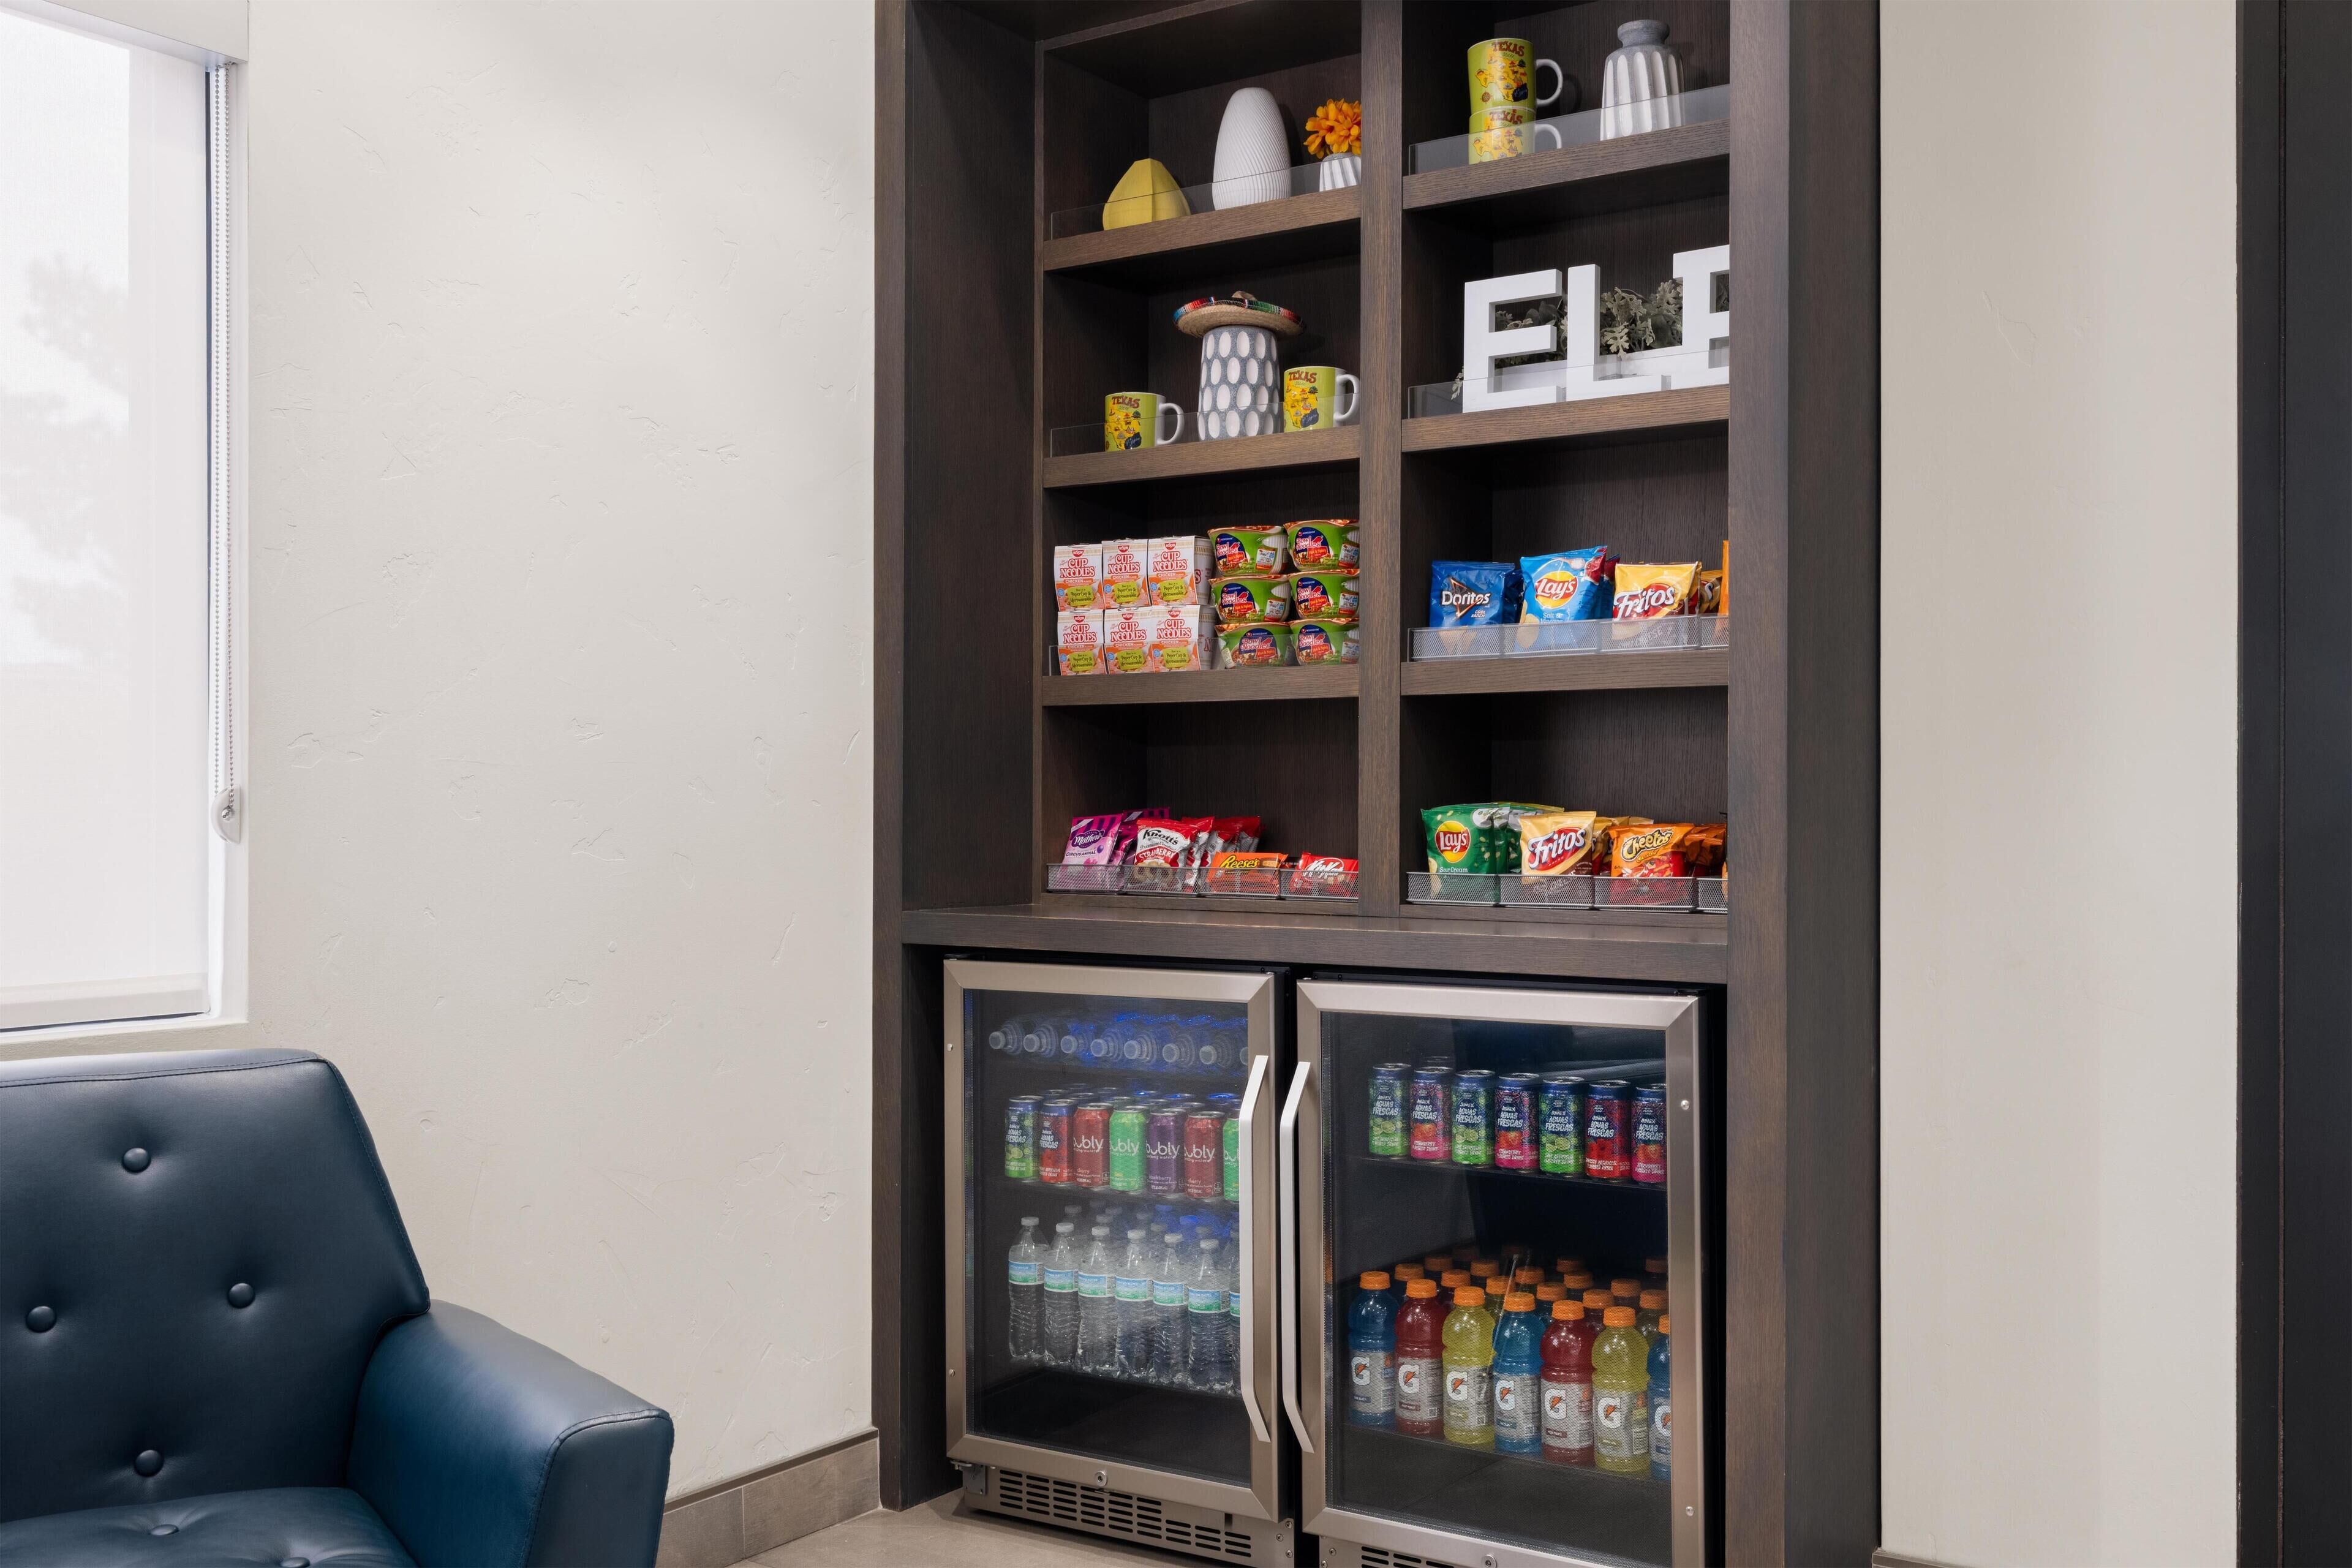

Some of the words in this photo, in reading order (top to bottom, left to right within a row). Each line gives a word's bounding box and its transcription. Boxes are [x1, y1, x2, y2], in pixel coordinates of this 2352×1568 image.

[1491, 41, 1525, 56] TEXAS
[1289, 371, 1317, 383] TEXAS
[1112, 396, 1140, 409] TEXAS
[1296, 541, 1321, 551] Noodles
[1161, 551, 1180, 561] CUP
[1216, 548, 1238, 557] Noodles
[1068, 558, 1088, 568] CUP
[1115, 554, 1134, 564] CUP
[1153, 559, 1187, 571] NOODLES
[1060, 567, 1095, 578] NOODLES
[1108, 562, 1140, 574] NOODLES
[1537, 579, 1575, 600] Lay's
[1298, 592, 1321, 601] Noodles
[1441, 590, 1491, 605] Doritos
[1613, 587, 1675, 622] Fritos
[1071, 624, 1090, 634] CUP
[1118, 622, 1139, 631] CUP
[1164, 619, 1185, 629] CUP
[1063, 632, 1096, 643] NOODLES
[1110, 630, 1147, 642] NOODLES
[1157, 628, 1191, 639] NOODLES
[1299, 639, 1324, 648] Noodles
[1074, 832, 1102, 846] Mother's
[1143, 829, 1178, 845] Knott's
[1439, 831, 1468, 853] Lay's
[1528, 829, 1585, 869] Fritos
[1622, 830, 1673, 861] Cheetos
[1139, 848, 1175, 859] STRAWBERRY
[1219, 854, 1260, 868] Reese's
[1412, 1110, 1437, 1120] FRESCAS
[1455, 1115, 1482, 1123] FRESCAS
[1498, 1118, 1523, 1127] FRESCAS
[1545, 1123, 1574, 1131] FRESCAS
[1588, 1128, 1614, 1138] FRESCAS
[1636, 1131, 1664, 1140] FRESCAS
[1351, 1356, 1370, 1385] G
[1398, 1364, 1420, 1394] G
[1446, 1371, 1468, 1401] G
[1495, 1380, 1515, 1411] G
[1544, 1389, 1567, 1420] G
[1597, 1397, 1621, 1428] G
